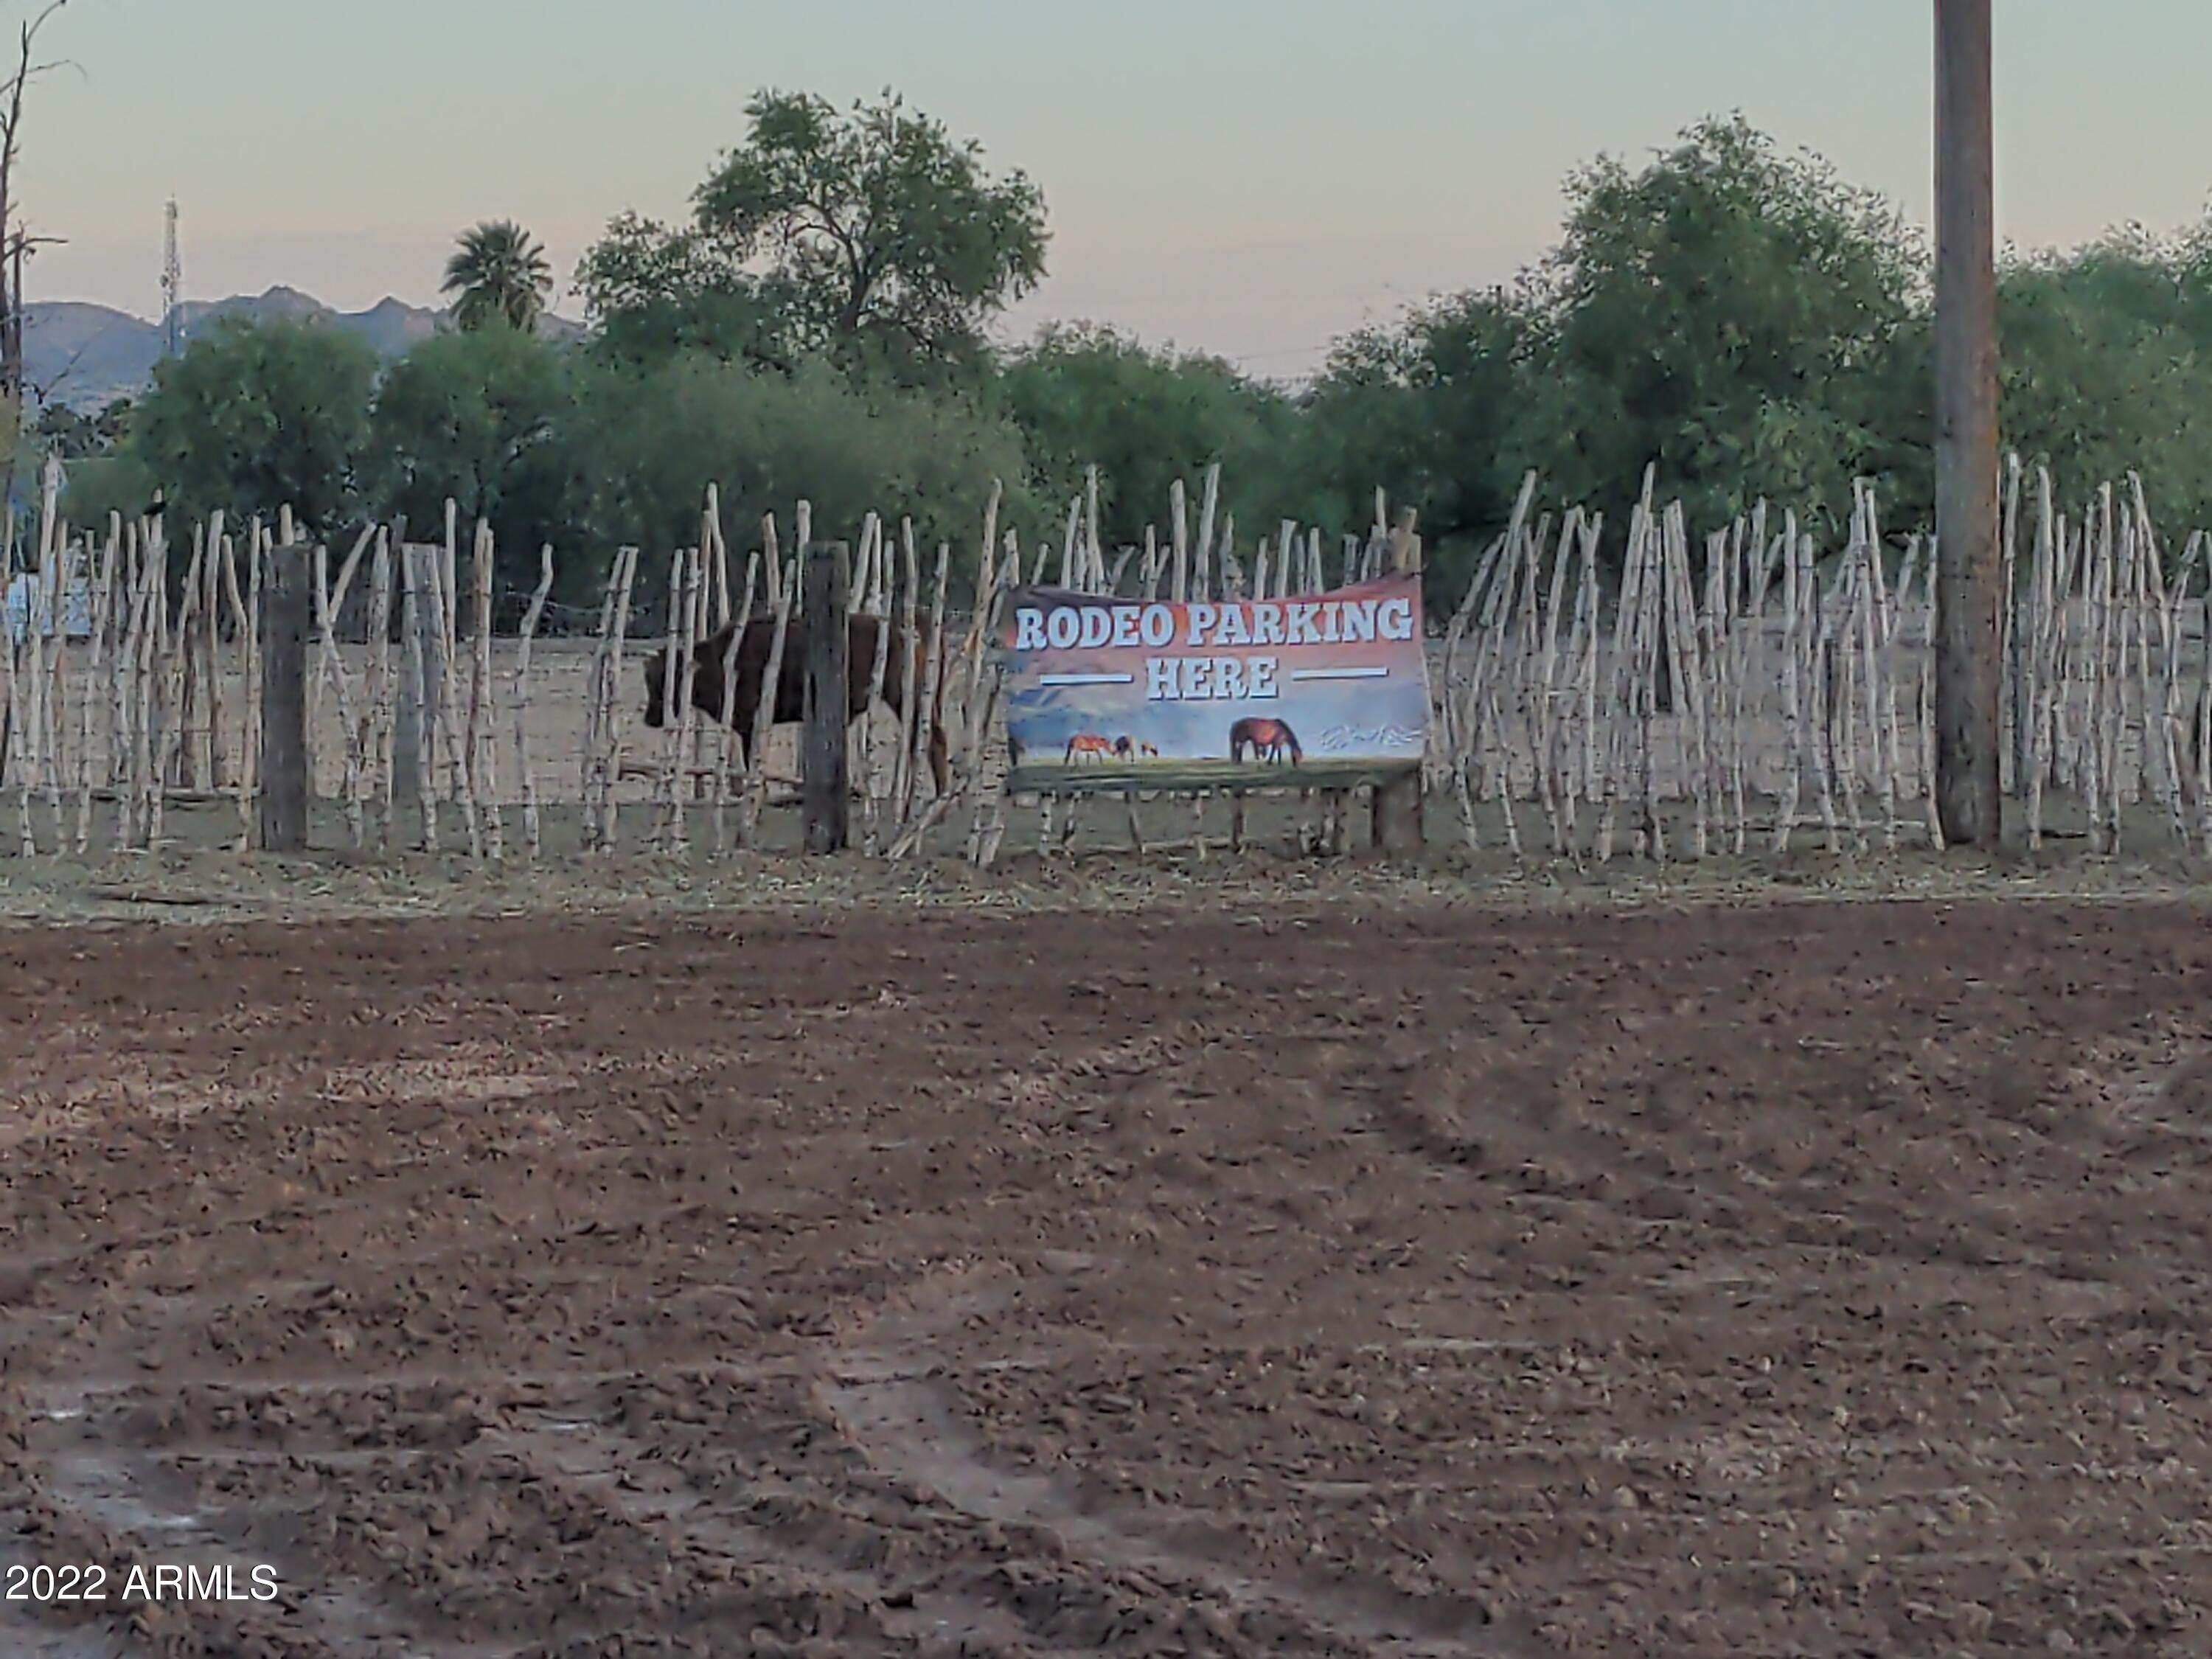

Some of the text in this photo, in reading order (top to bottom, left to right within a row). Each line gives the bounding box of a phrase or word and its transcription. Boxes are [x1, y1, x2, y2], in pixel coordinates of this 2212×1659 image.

[1015, 598, 1413, 650] RODEO PARKING
[1146, 657, 1279, 700] HERE
